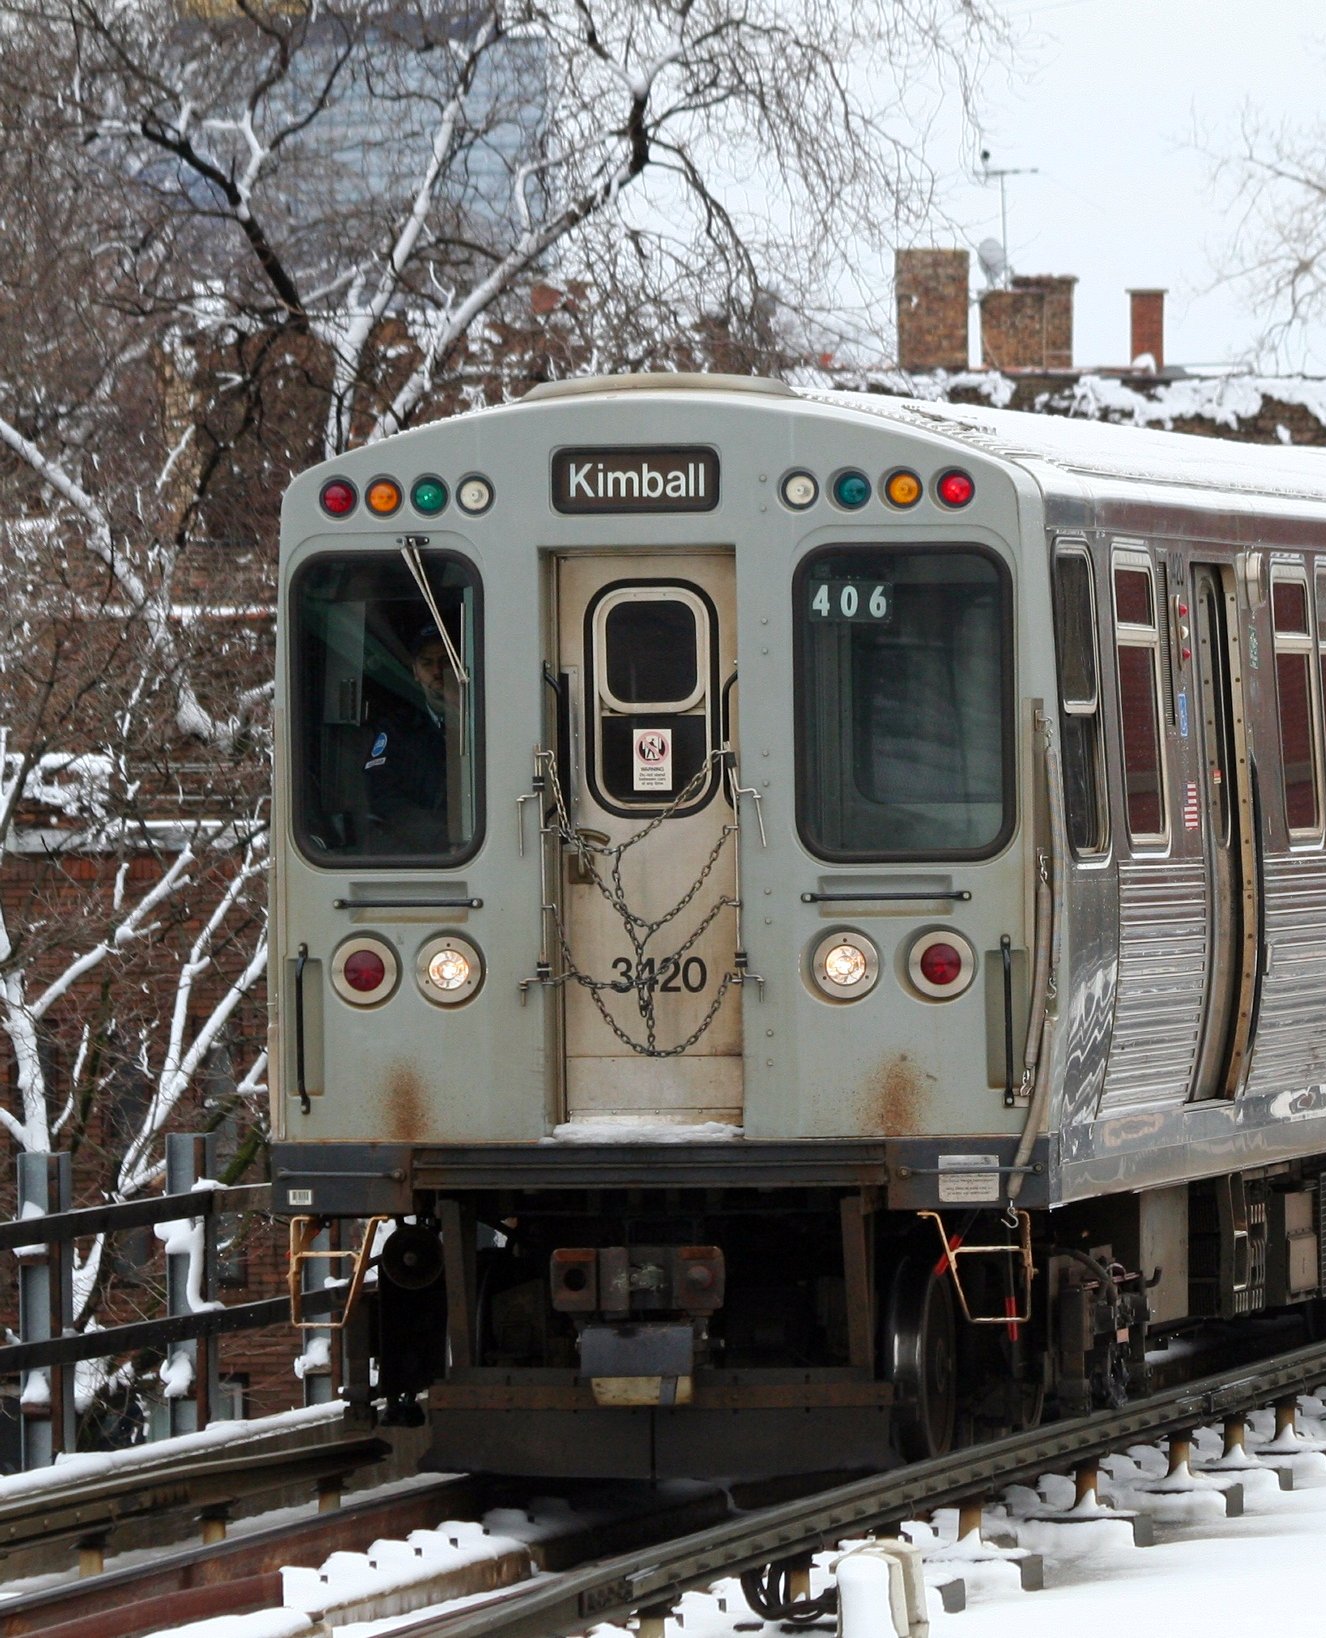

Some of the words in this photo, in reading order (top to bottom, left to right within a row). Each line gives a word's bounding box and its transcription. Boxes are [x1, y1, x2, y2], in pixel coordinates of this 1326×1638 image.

[568, 463, 705, 498] Kimball
[812, 584, 887, 618] 406
[611, 956, 708, 993] 3420
